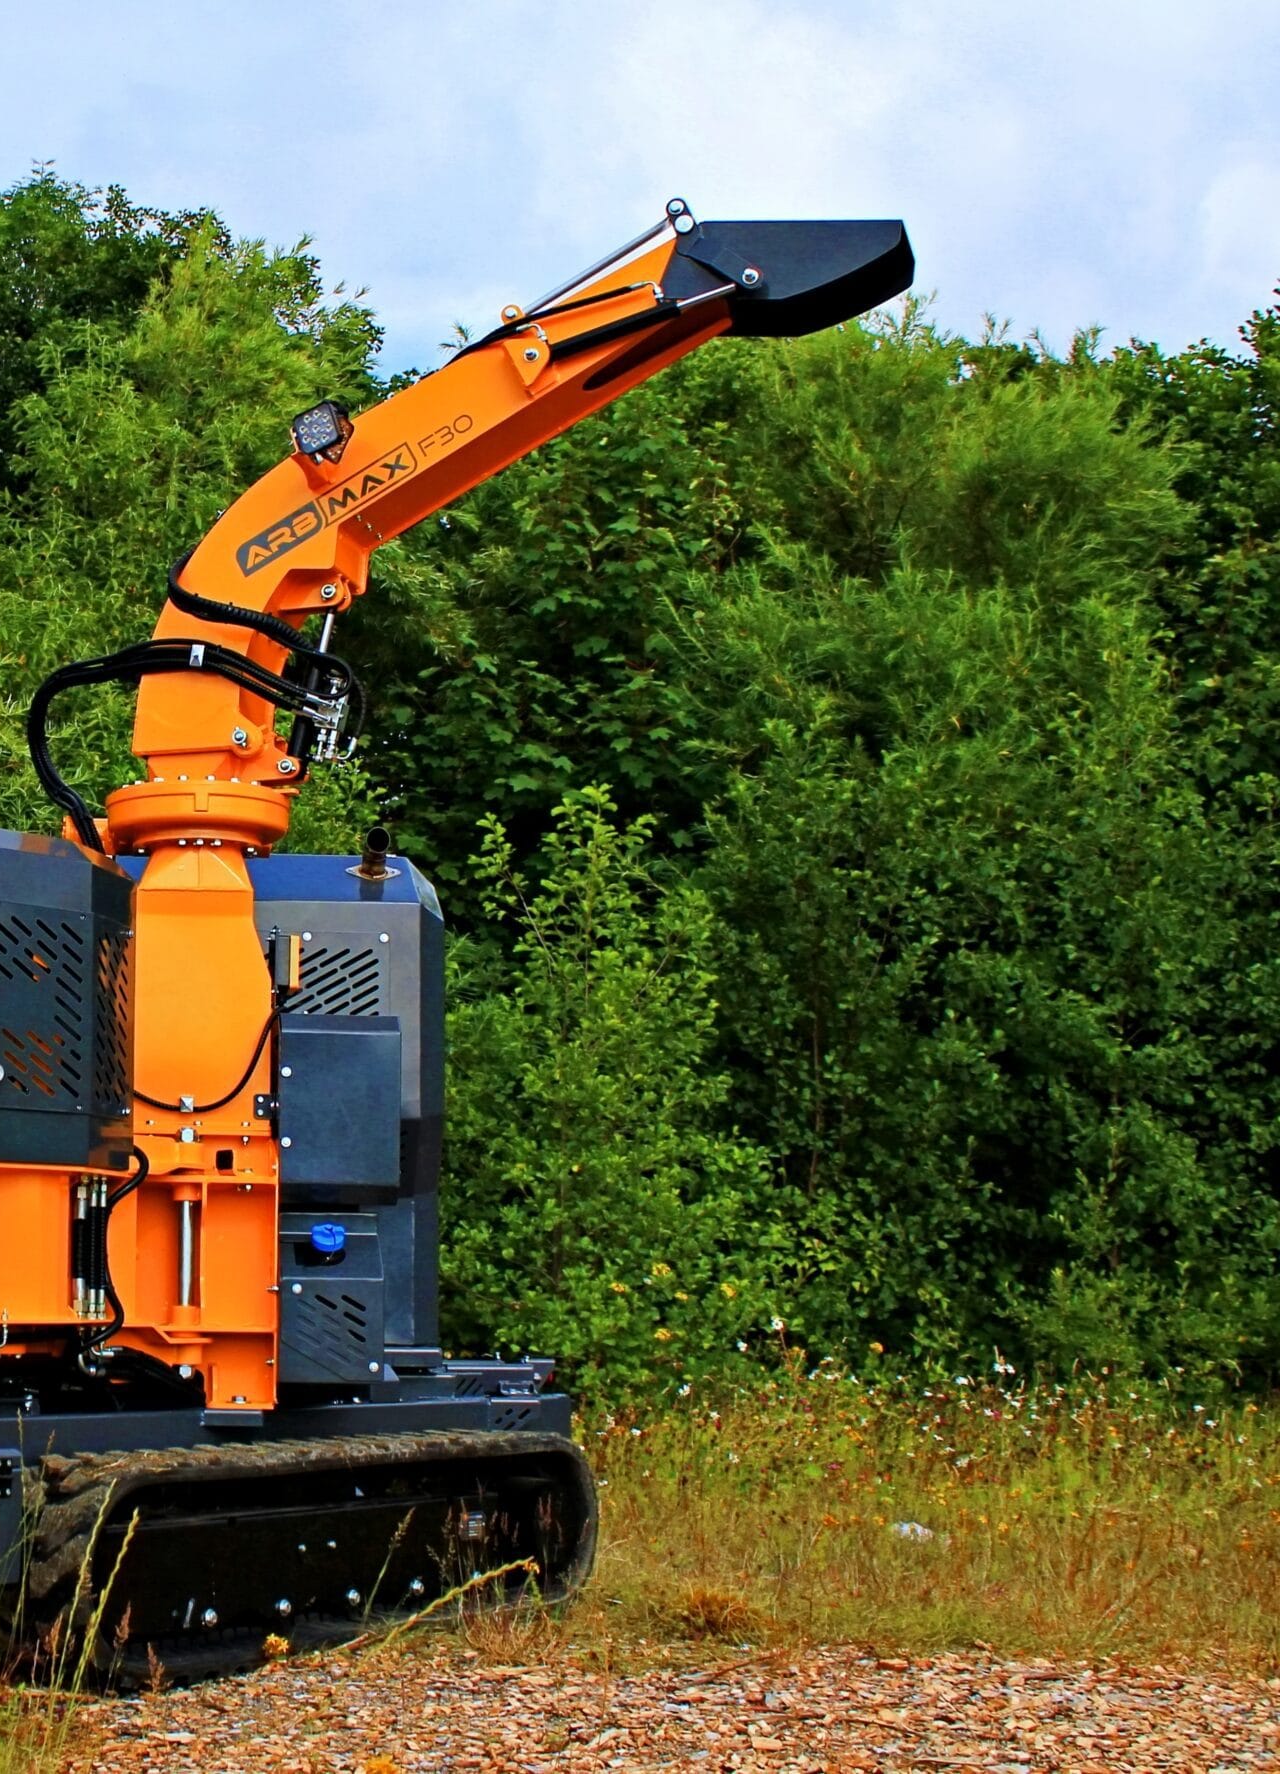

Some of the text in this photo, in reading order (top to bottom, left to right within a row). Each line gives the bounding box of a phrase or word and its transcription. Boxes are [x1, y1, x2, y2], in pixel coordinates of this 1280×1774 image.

[245, 414, 473, 570] ARB MAX F30
